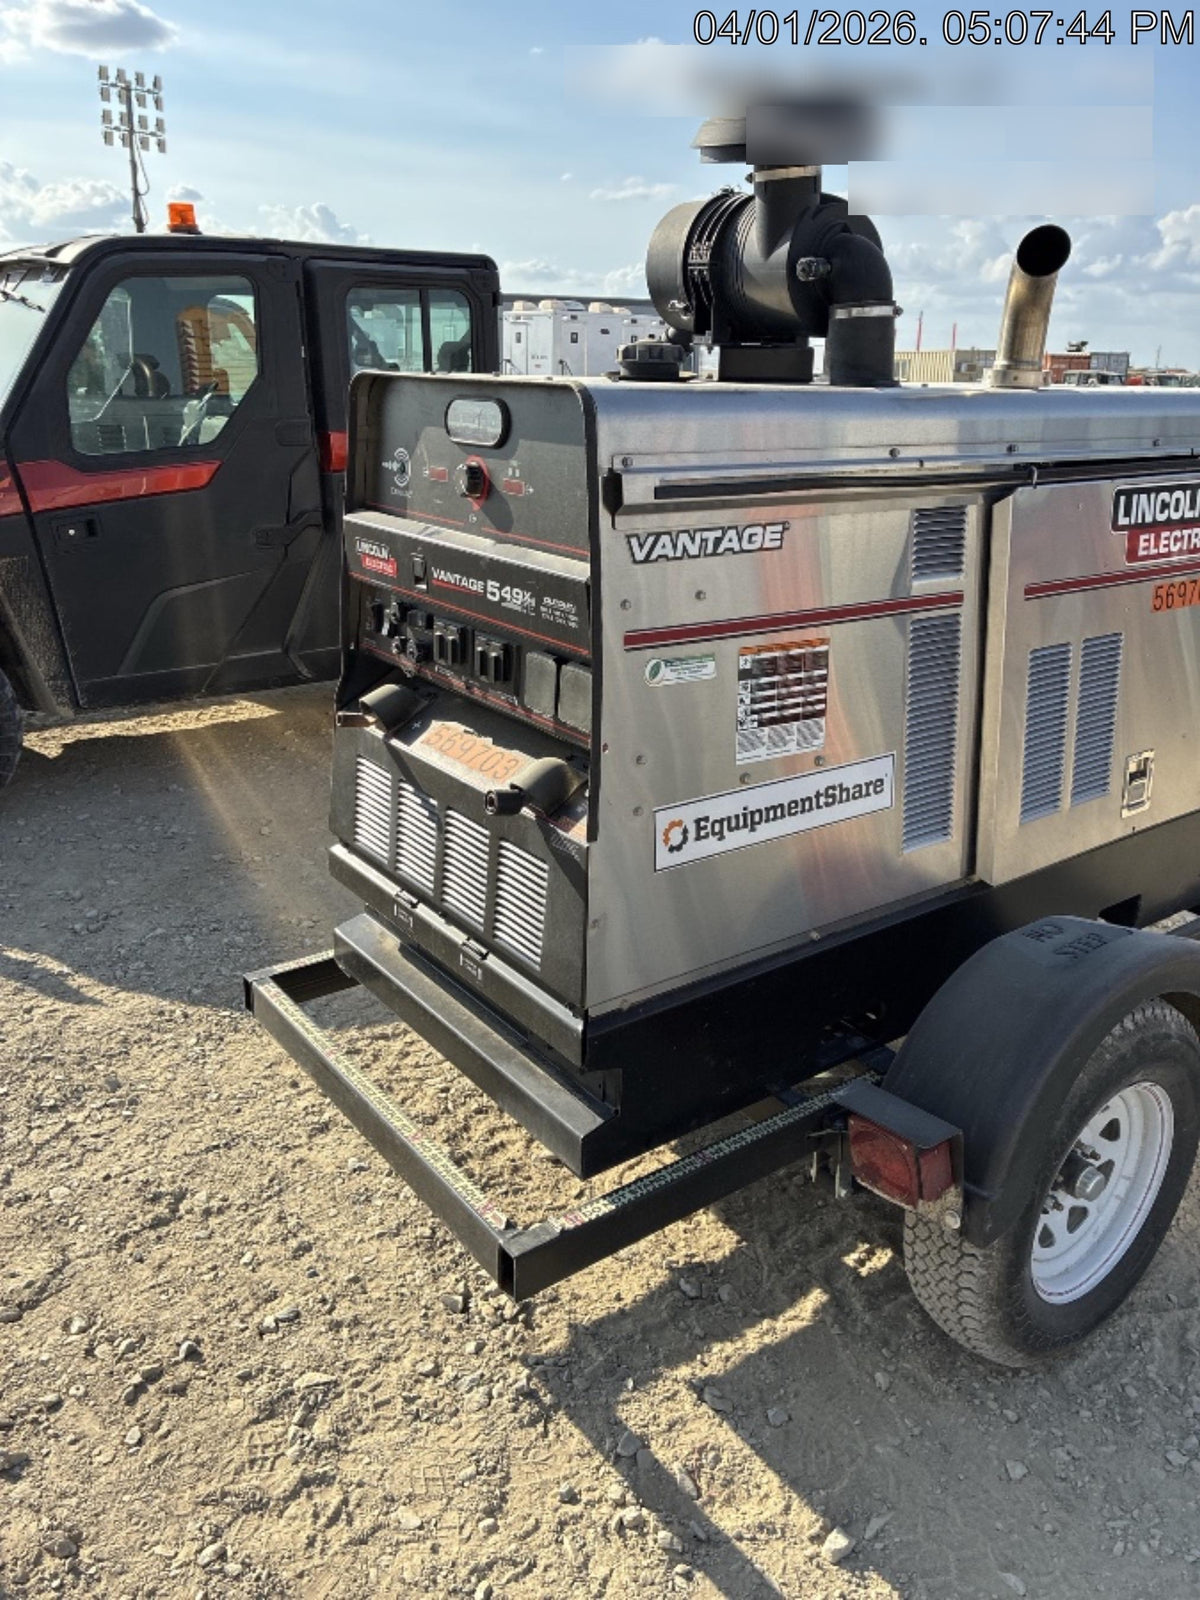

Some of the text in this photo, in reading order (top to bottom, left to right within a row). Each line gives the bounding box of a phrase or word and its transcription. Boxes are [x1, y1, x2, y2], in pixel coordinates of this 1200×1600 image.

[626, 521, 786, 564] VANTAGE
[431, 566, 484, 593] VANTAGE
[1153, 579, 1200, 611] 5697
[421, 724, 519, 780] 569703
[694, 778, 884, 842] EquipmentShare
